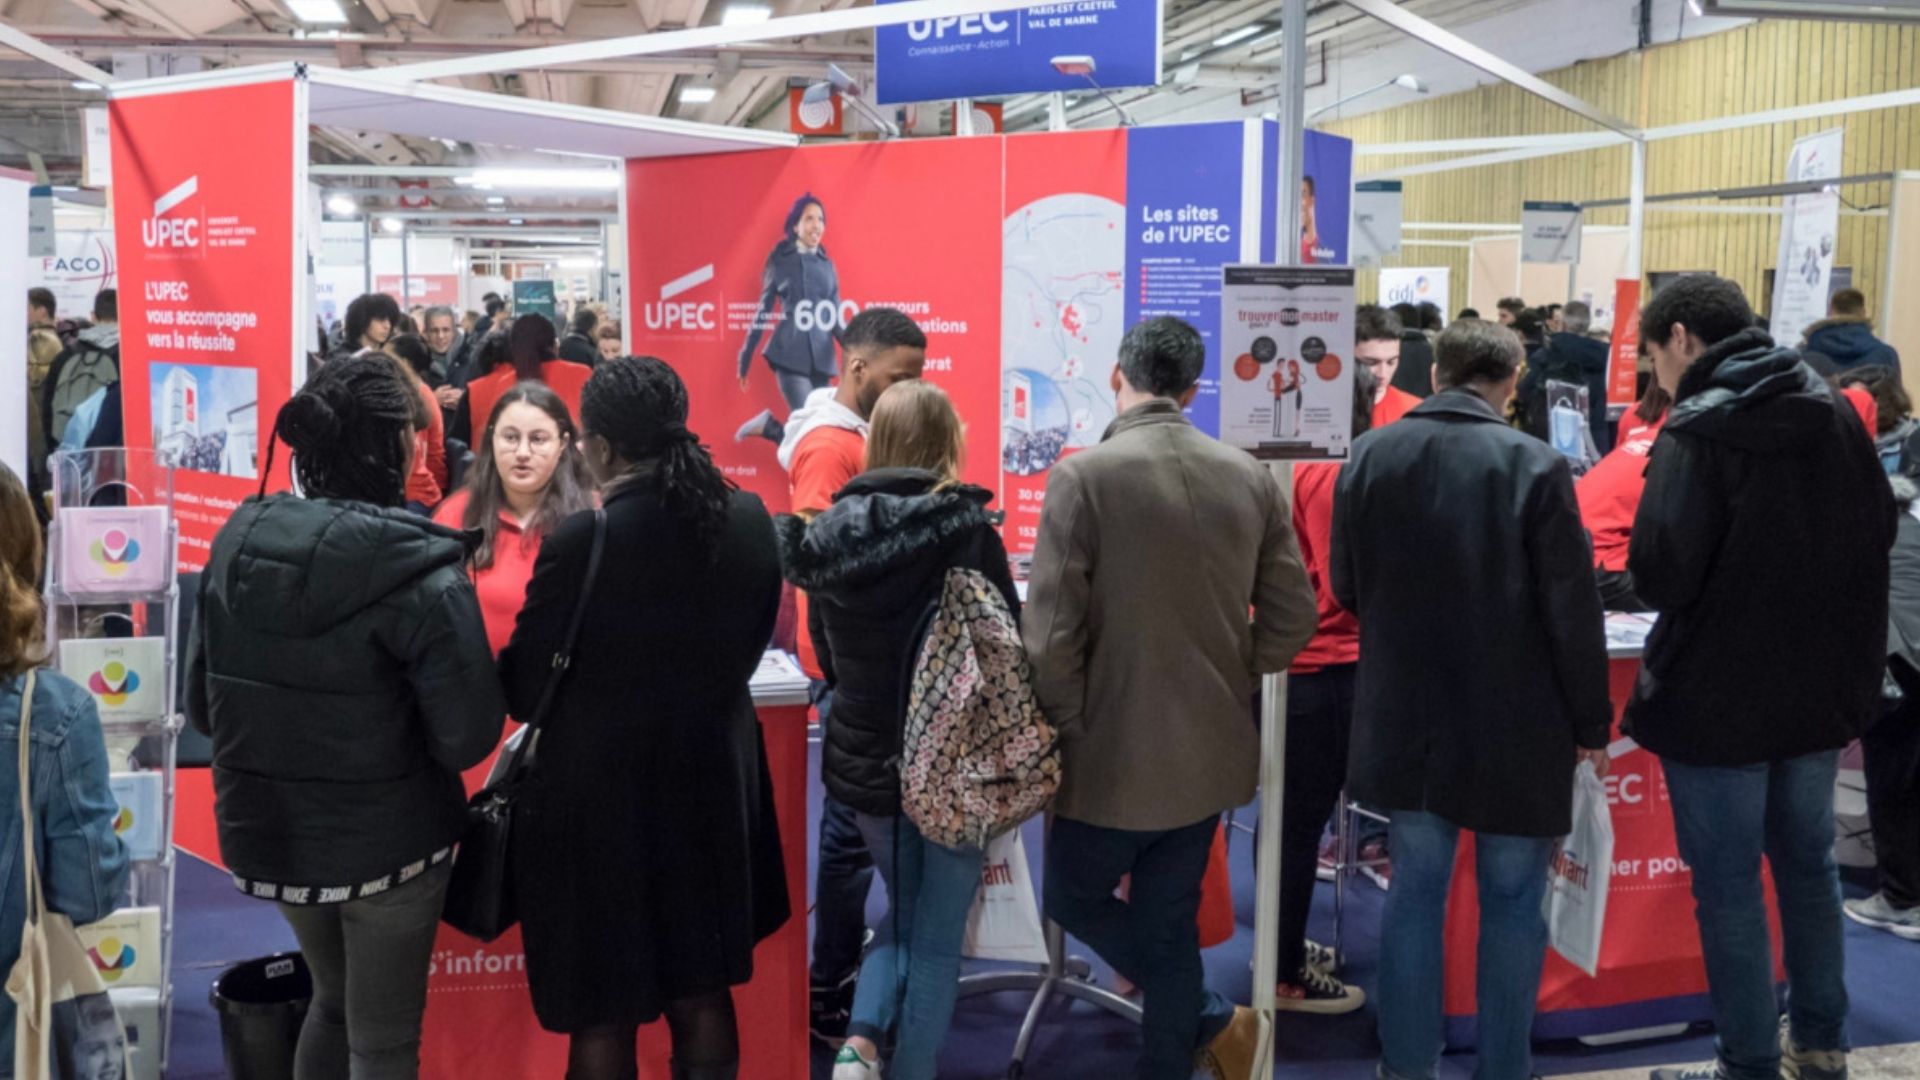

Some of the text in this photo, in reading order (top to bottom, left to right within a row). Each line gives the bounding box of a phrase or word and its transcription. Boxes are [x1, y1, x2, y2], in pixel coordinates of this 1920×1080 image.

[1028, 14, 1098, 29] VAL DE MARNE
[1143, 203, 1219, 223] Les sites
[142, 216, 199, 247] UPEC
[1142, 226, 1231, 244] de l'UPEC
[42, 257, 100, 272] FACO
[144, 281, 189, 301] L'UPEC
[146, 310, 257, 332] vous accompagne
[644, 301, 715, 330] UPEC
[794, 298, 860, 332] 600
[915, 317, 968, 333] ations
[1238, 309, 1279, 322] trouver
[1301, 310, 1339, 323] master
[147, 329, 236, 352] vers la réussite
[922, 357, 952, 371] orat
[1648, 856, 1691, 879] pou
[282, 885, 311, 904] NIKE
[359, 874, 391, 897] NIKE
